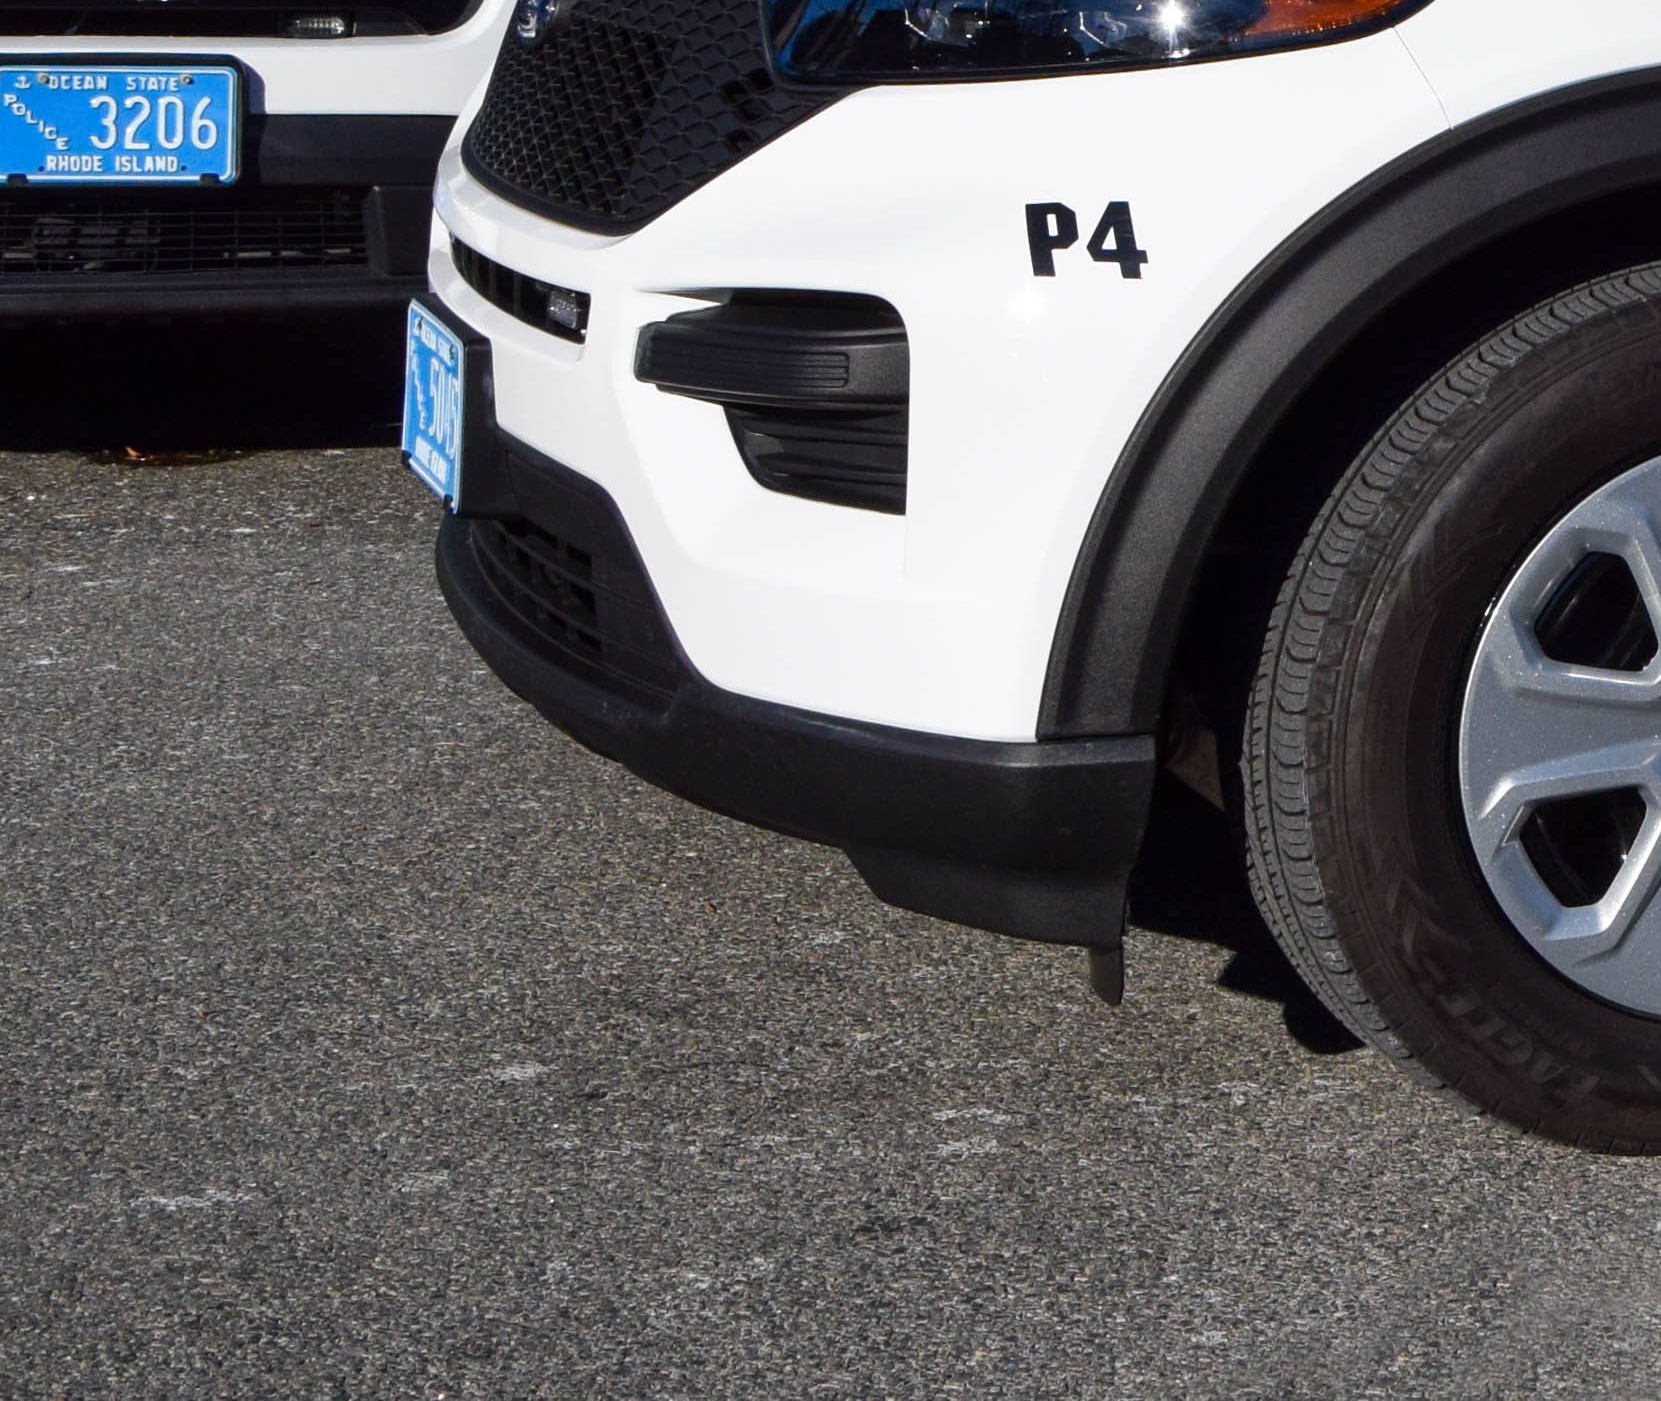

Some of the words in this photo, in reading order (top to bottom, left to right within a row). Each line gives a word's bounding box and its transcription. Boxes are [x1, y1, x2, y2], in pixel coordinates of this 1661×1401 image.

[49, 75, 109, 91] OCEAN
[125, 75, 180, 91] STATE
[3, 93, 69, 151] POLICE
[89, 95, 218, 150] 3206
[45, 154, 103, 173] RHODE
[115, 154, 178, 173] ISLAND
[1025, 201, 1149, 280] P4
